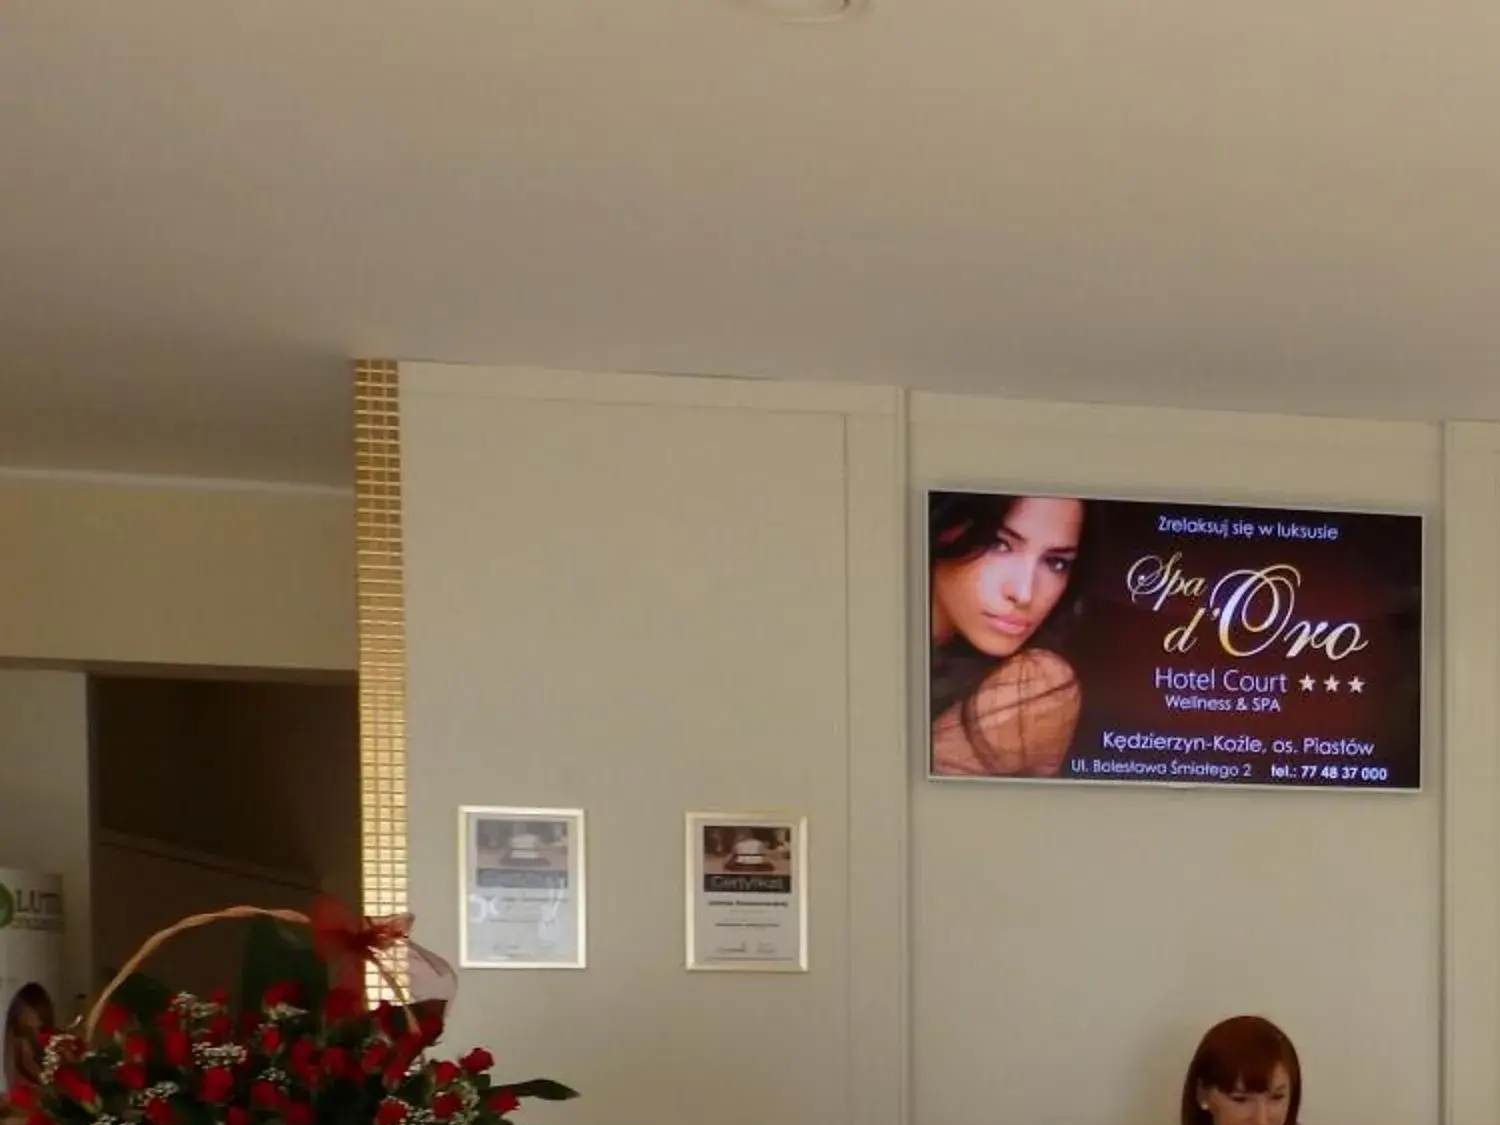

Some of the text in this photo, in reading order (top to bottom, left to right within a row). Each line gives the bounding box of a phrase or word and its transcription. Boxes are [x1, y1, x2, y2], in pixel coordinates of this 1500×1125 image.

[1158, 515, 1339, 540] Zrelaksuj się w luksusie
[1127, 549, 1203, 611] Spa
[1163, 564, 1369, 660] d'Oro
[1155, 667, 1288, 693] Hotel Court
[1165, 694, 1281, 712] Wellness & SPA
[1273, 741, 1297, 753] os.
[1303, 738, 1375, 757] Piastów
[1071, 759, 1088, 772] Ul.
[1093, 760, 1167, 776] Bolesława
[1243, 765, 1252, 776] 2
[1271, 765, 1296, 778] tel.:
[1301, 766, 1317, 778] 77
[1320, 767, 1337, 779] 48
[1341, 767, 1357, 779] 37
[1361, 768, 1387, 780] 000
